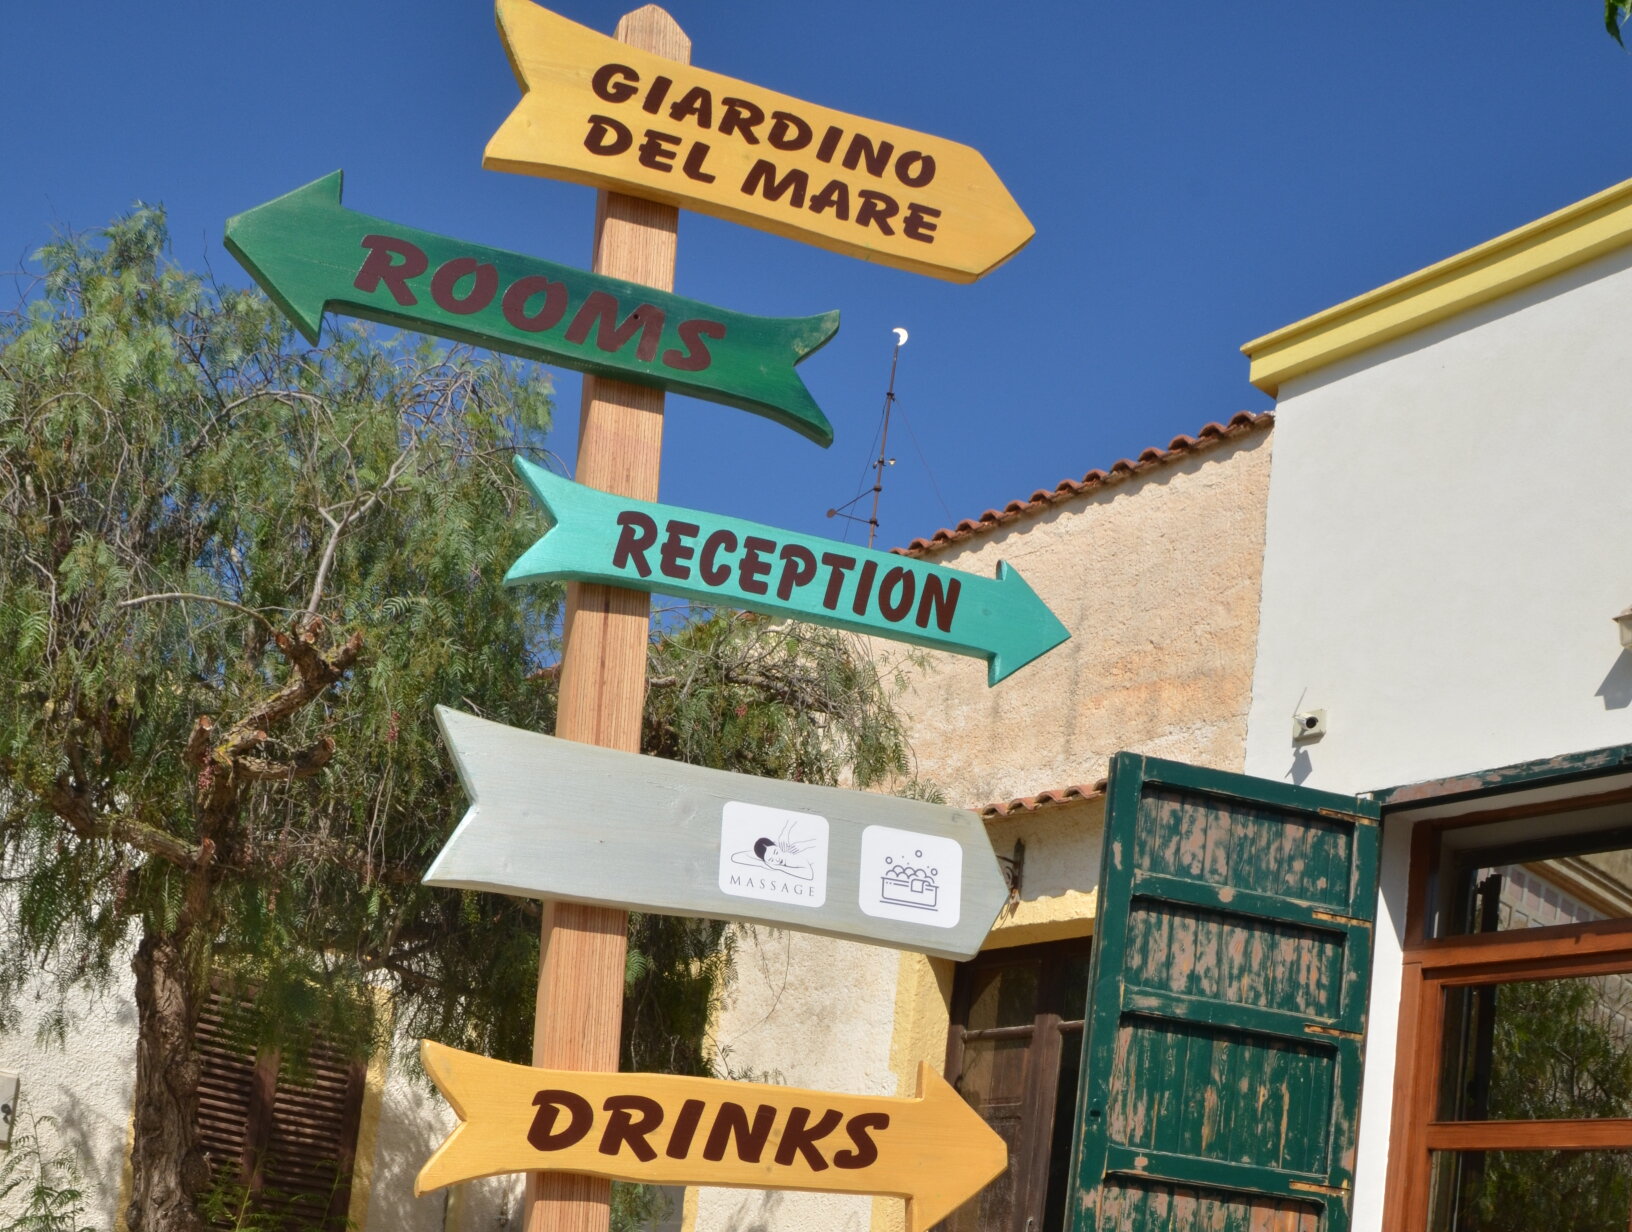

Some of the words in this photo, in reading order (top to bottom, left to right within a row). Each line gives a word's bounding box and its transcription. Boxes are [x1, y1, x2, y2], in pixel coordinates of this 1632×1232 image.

[583, 114, 717, 184] DEL
[741, 158, 942, 244] MARE
[591, 63, 937, 189] GIARDINO
[353, 234, 726, 372] ROOMS
[612, 511, 962, 633] RECEPTION
[729, 874, 816, 897] MASSAGE
[526, 1089, 890, 1173] DRINKS
